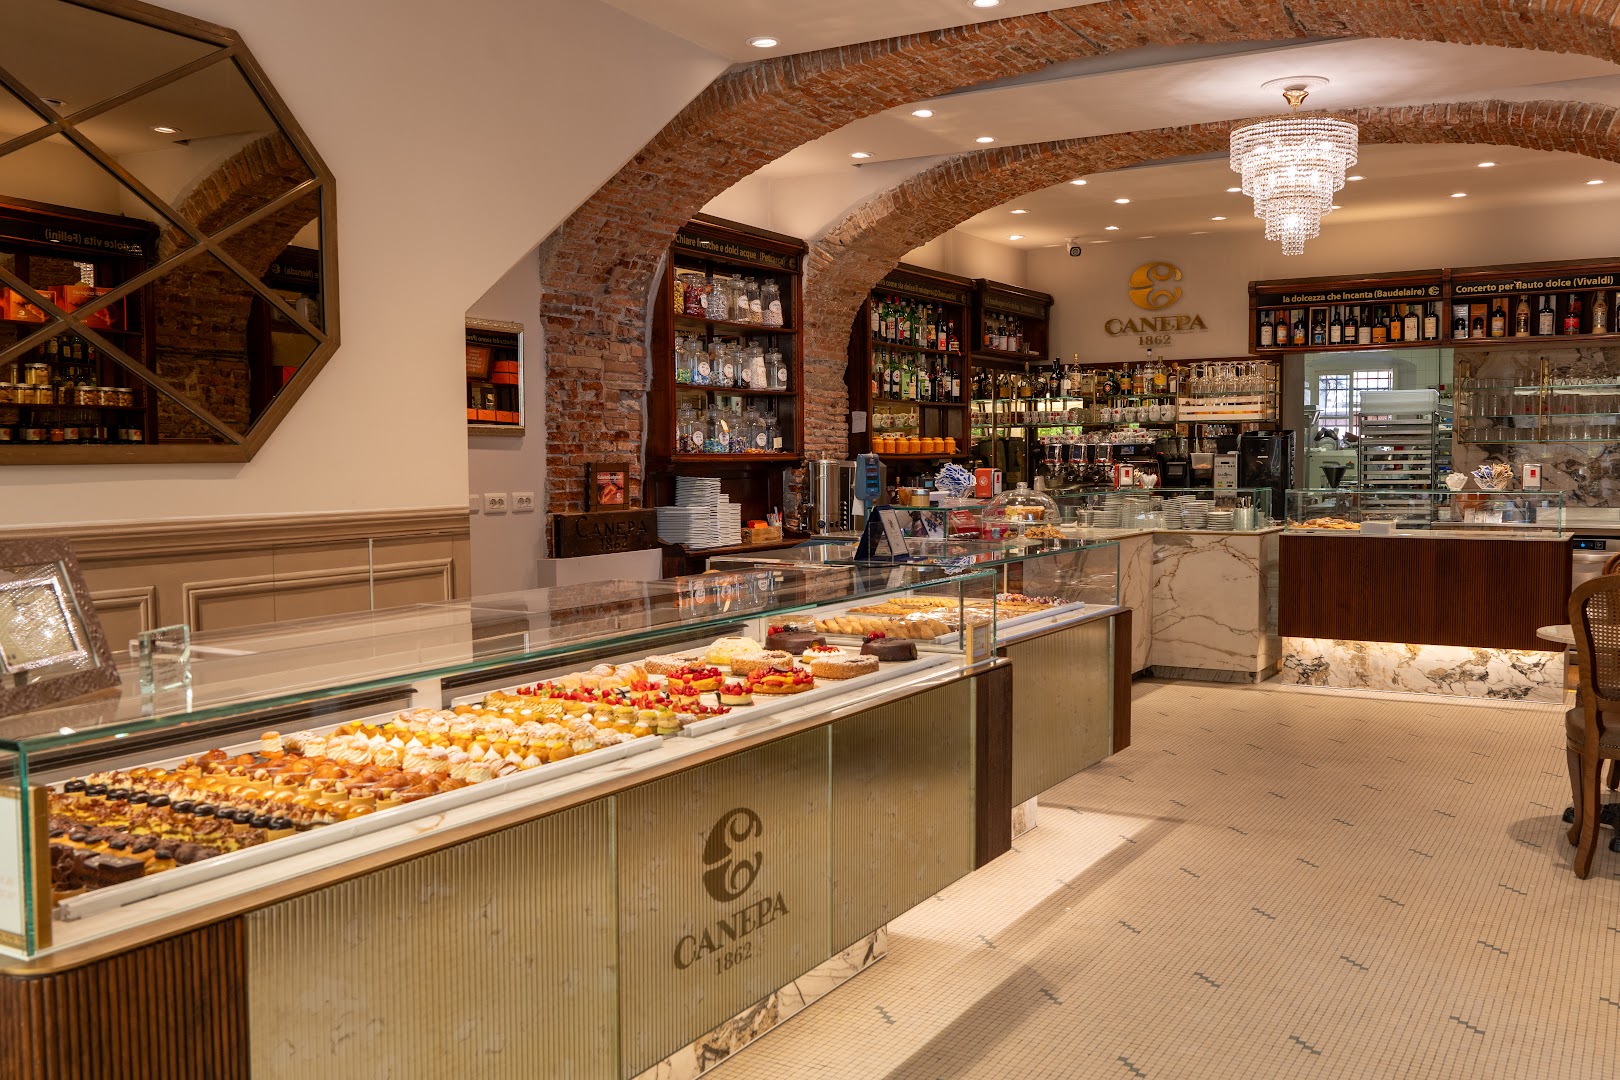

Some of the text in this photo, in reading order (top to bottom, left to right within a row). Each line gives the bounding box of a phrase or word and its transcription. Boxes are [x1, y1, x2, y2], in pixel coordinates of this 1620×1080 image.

[675, 233, 696, 247] Chiare
[724, 245, 739, 256] dolci
[739, 249, 757, 260] acque
[759, 252, 786, 266] (Petrarca)
[1291, 294, 1326, 303] dolcezza
[1327, 292, 1342, 301] che
[1342, 291, 1373, 300] incanta
[1374, 287, 1425, 300] (Baudelaire)
[1455, 275, 1614, 294] Concerto per flauto dolce (Vivaldi)
[1104, 314, 1209, 336] CANEPA
[1138, 334, 1171, 346] 1862
[576, 516, 648, 539] CANEPA
[600, 536, 628, 551] 1862
[673, 891, 790, 970] CANEPA
[715, 941, 753, 976] 1862
